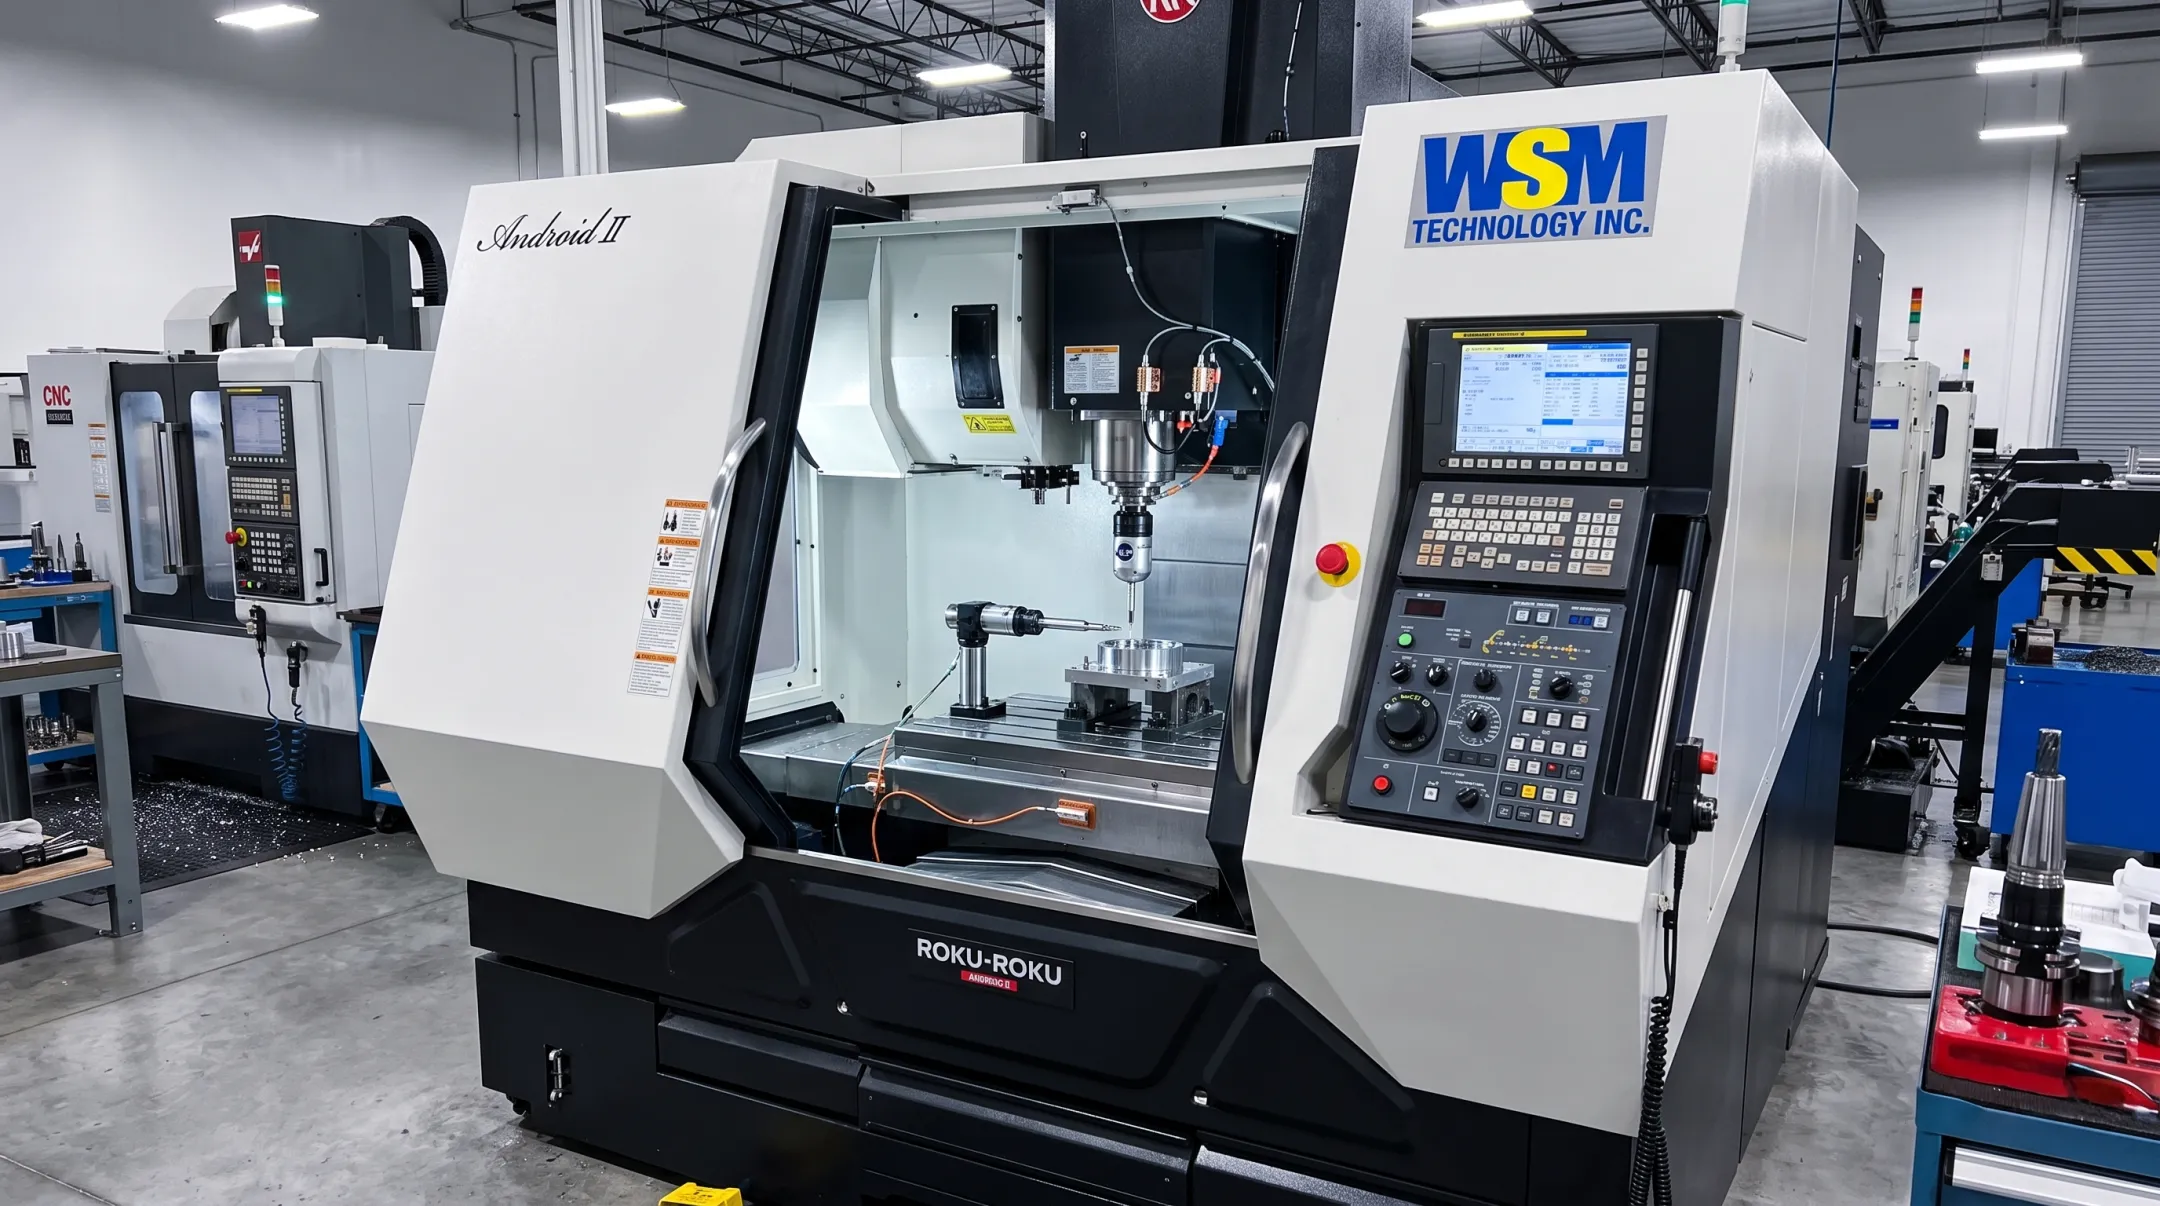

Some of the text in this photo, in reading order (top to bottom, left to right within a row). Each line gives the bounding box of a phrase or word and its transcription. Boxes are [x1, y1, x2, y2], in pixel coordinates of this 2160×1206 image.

[1424, 121, 1647, 214] WSM
[476, 207, 631, 252] Android II
[1412, 207, 1650, 243] TECHNOLOGY INC.
[43, 385, 71, 406] CNC
[917, 938, 1062, 986] ROKU-ROKU
